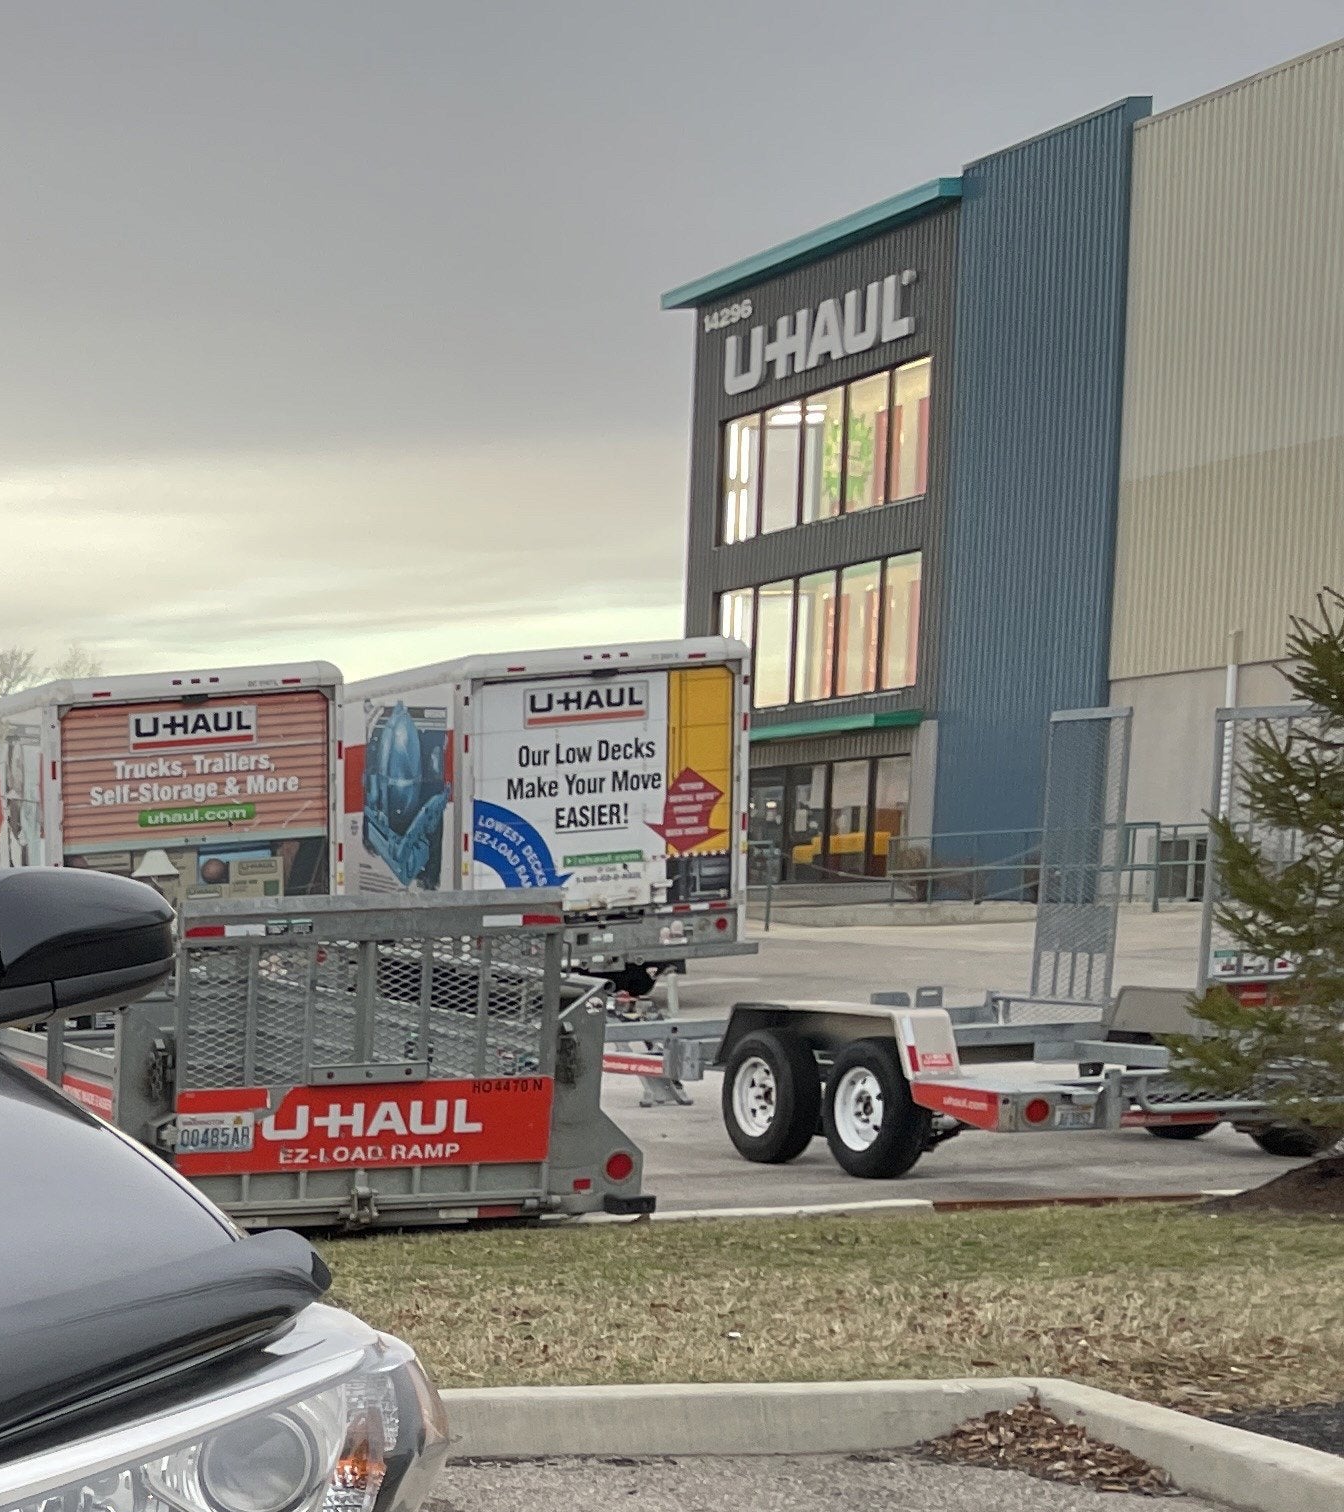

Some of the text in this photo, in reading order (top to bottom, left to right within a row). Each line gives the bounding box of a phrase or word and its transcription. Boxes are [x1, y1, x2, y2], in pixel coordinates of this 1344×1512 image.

[704, 299, 753, 333] 14296
[529, 687, 643, 713] U-HAUL
[134, 710, 252, 738] U-HAUL
[113, 752, 276, 780] Trucks, Trailers,
[518, 737, 656, 768] Our Low Decks
[89, 774, 300, 807] Self-Storage & More
[507, 777, 559, 801] Make
[565, 773, 607, 796] Your
[611, 769, 662, 793] Move
[147, 807, 248, 825] uhaul.com
[555, 803, 629, 829] EASIER!
[477, 814, 548, 888] LOWEST DECKS
[261, 1098, 483, 1141] U-HAUL
[278, 1143, 461, 1165] EZ-LOAD RAMP
